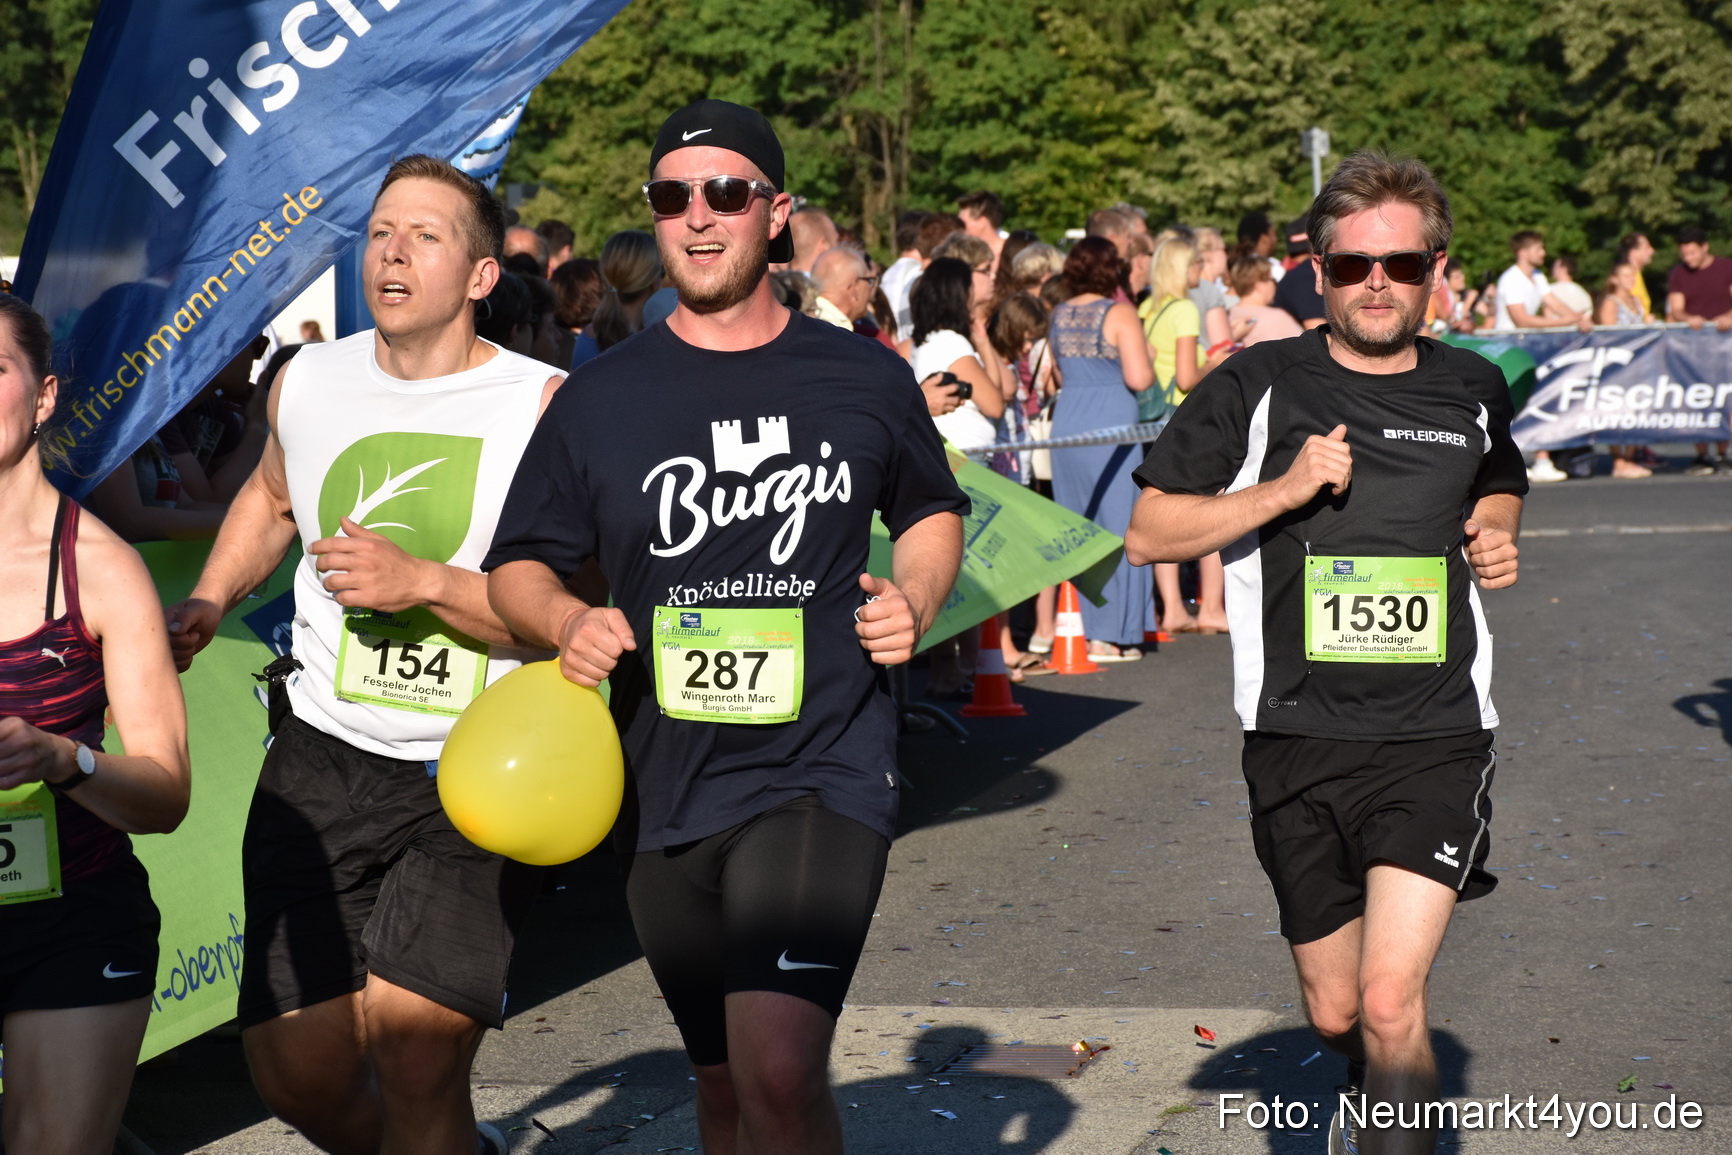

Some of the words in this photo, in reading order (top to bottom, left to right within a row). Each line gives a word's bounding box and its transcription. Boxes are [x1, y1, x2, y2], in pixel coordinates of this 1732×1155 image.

[1558, 374, 1732, 412] Fischer
[1576, 411, 1722, 430] AUTOMOBILE
[1396, 428, 1467, 448] PFLEIDERER
[641, 441, 851, 565] Burgis
[1323, 572, 1373, 583] firmenlauf
[666, 573, 816, 606] Knödelliebe
[1377, 581, 1404, 591] 2018
[1323, 594, 1429, 633] 1530
[671, 626, 722, 637] firmenlauf
[1338, 633, 1369, 644] Jürke
[1372, 634, 1415, 646] Rüdiger
[727, 635, 756, 646] 2018
[1322, 644, 1358, 652] Pfleiderer
[1359, 645, 1405, 653] Deutschland
[372, 638, 451, 685] 154
[684, 649, 769, 691] 287
[363, 675, 409, 691] Fesseler
[411, 684, 452, 698] Jochen
[381, 690, 417, 702] Bionorica
[418, 695, 429, 703] SE
[681, 690, 745, 704] Wingenroth
[748, 693, 776, 703] Marc
[702, 703, 727, 713] Burgis
[728, 704, 753, 712] GmbH
[1434, 852, 1460, 868] erima
